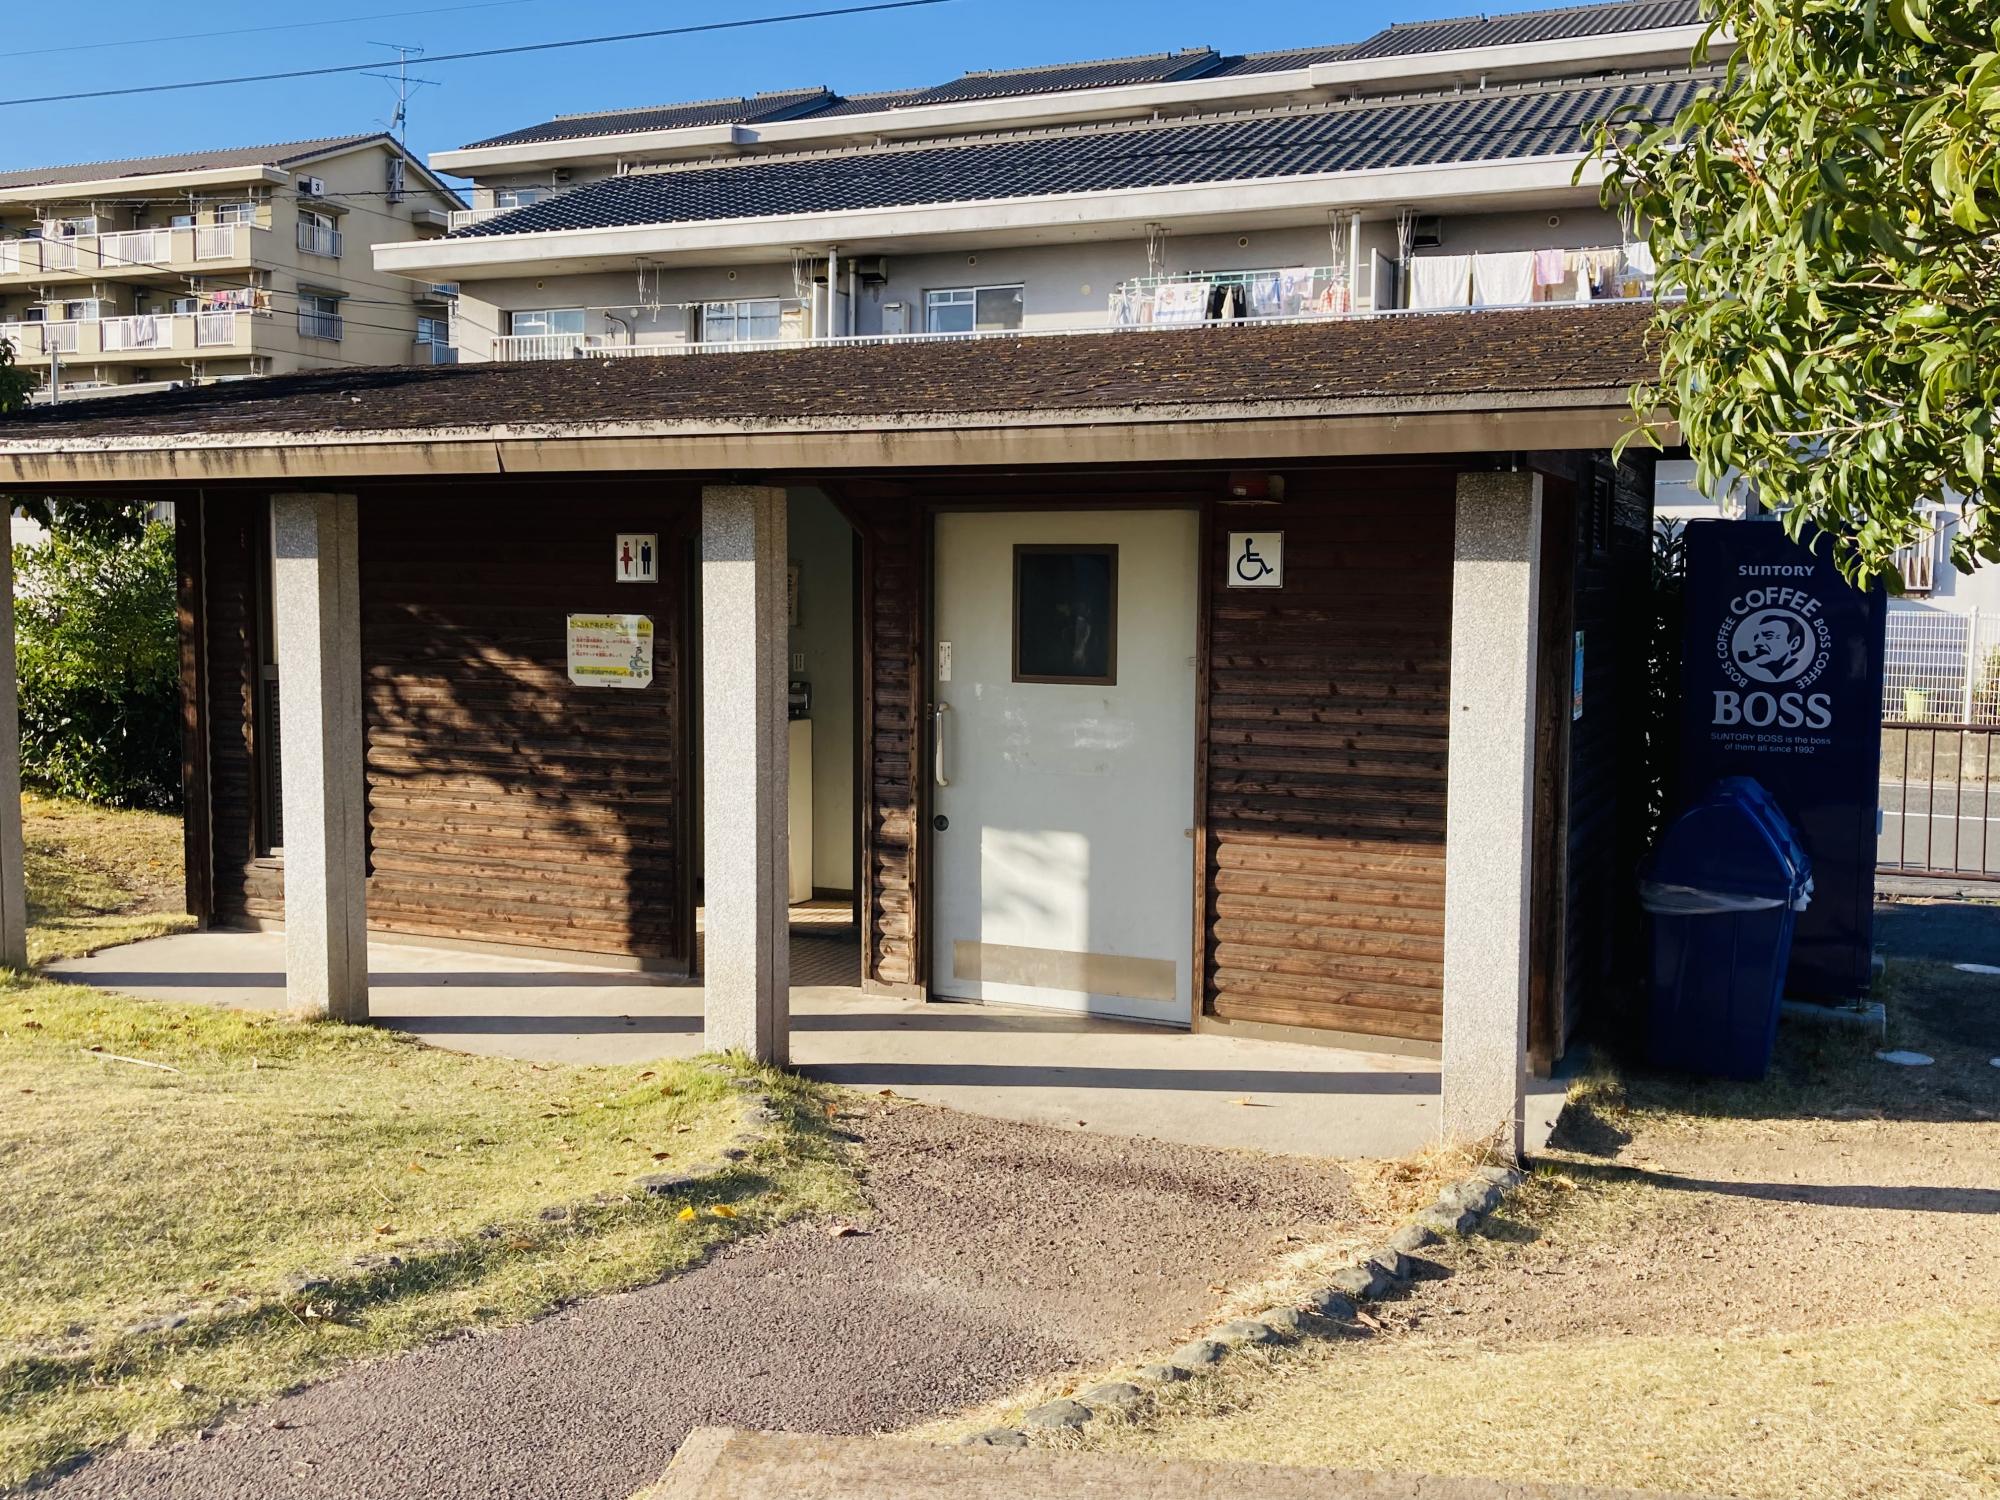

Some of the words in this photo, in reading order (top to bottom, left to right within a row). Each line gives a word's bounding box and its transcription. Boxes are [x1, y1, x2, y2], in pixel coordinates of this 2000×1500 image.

[1738, 565, 1815, 577] SUNTORY
[1730, 586, 1822, 618] COFFEE
[1717, 616, 1736, 659] COFFEE
[1813, 617, 1832, 649] BOSS
[1721, 660, 1749, 688] BOSS
[1795, 651, 1830, 690] COFFEE
[1712, 690, 1832, 729] BOSS
[1710, 732, 1755, 742] SUNTORY
[1757, 734, 1783, 743] BOSS
[1785, 735, 1792, 743] is
[1794, 736, 1808, 744] the
[1810, 736, 1831, 745] boss
[1734, 743, 1756, 751] them
[1757, 744, 1768, 752] all
[1769, 744, 1792, 753] since
[1794, 745, 1815, 754] 1992
